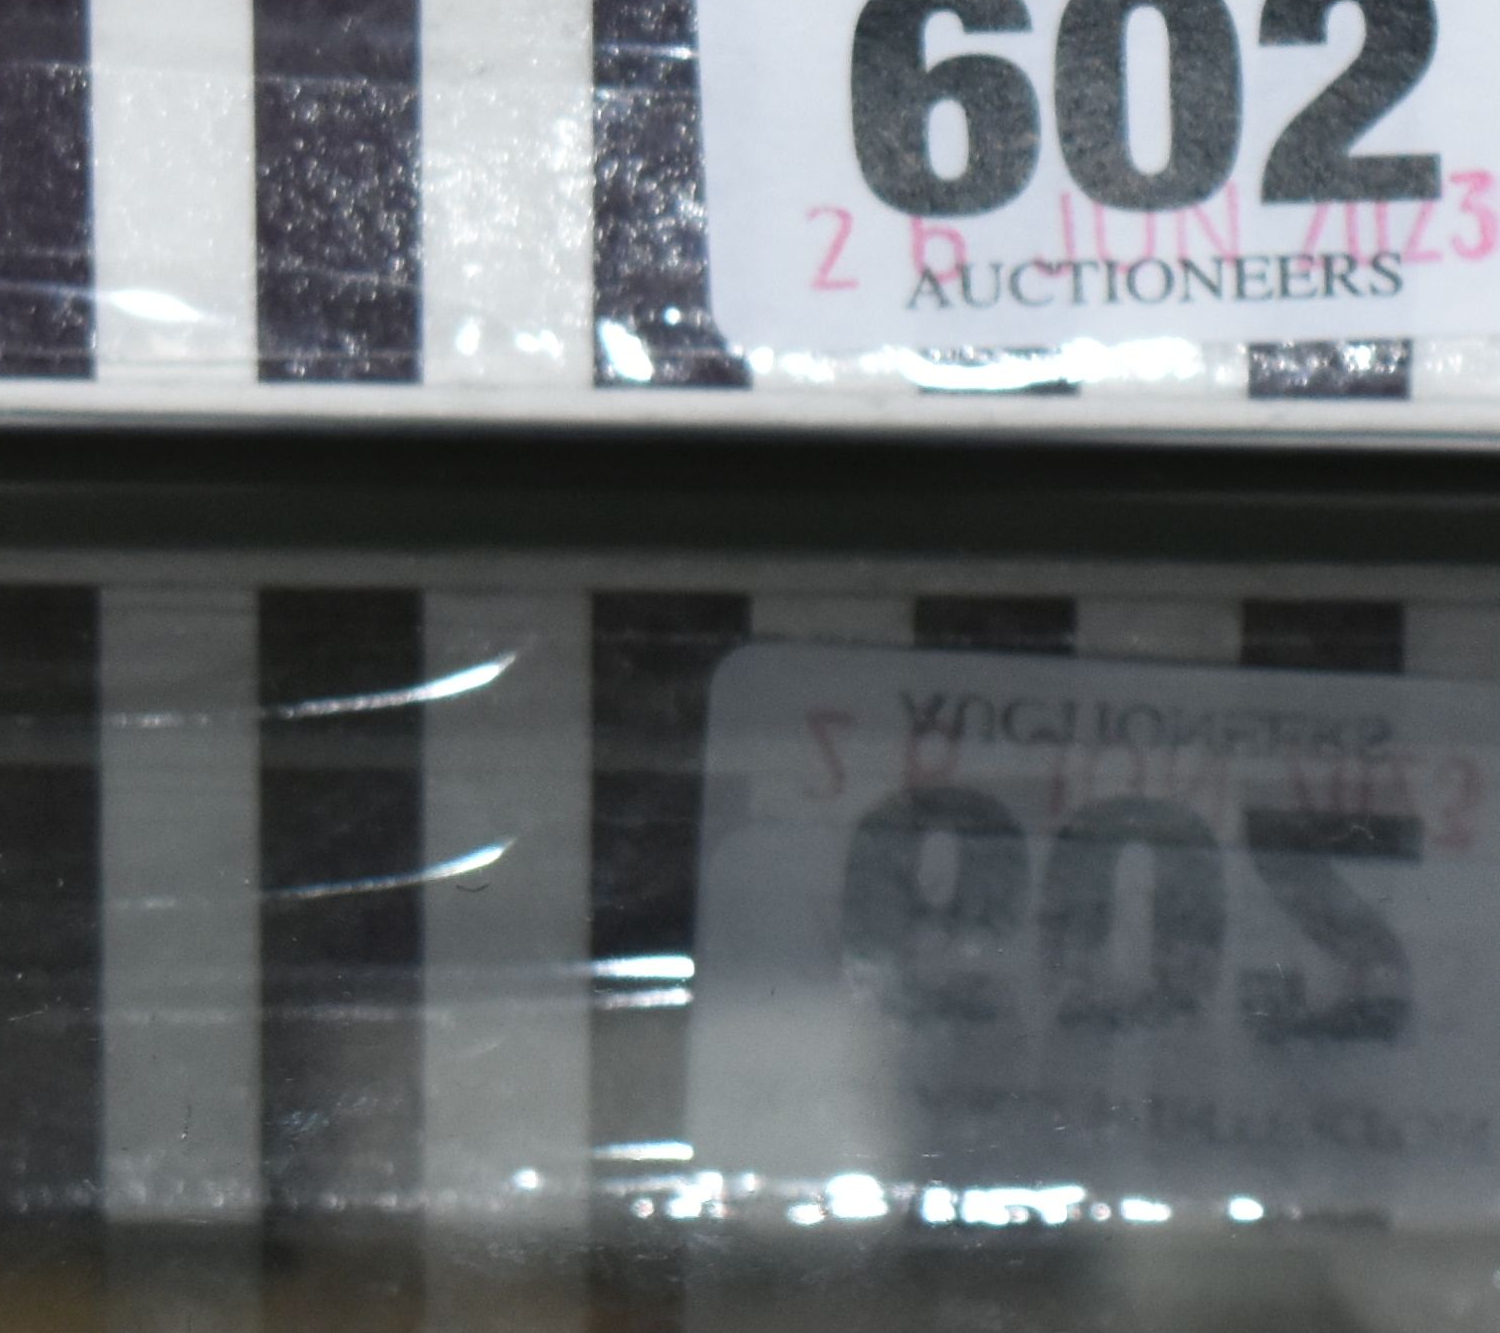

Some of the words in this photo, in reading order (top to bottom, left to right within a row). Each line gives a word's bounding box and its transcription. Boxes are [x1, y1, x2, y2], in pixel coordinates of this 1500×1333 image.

[1034, 178, 1240, 279] JUN
[1298, 169, 1500, 271] 2023
[906, 250, 1405, 311] AUCTIONEERS
